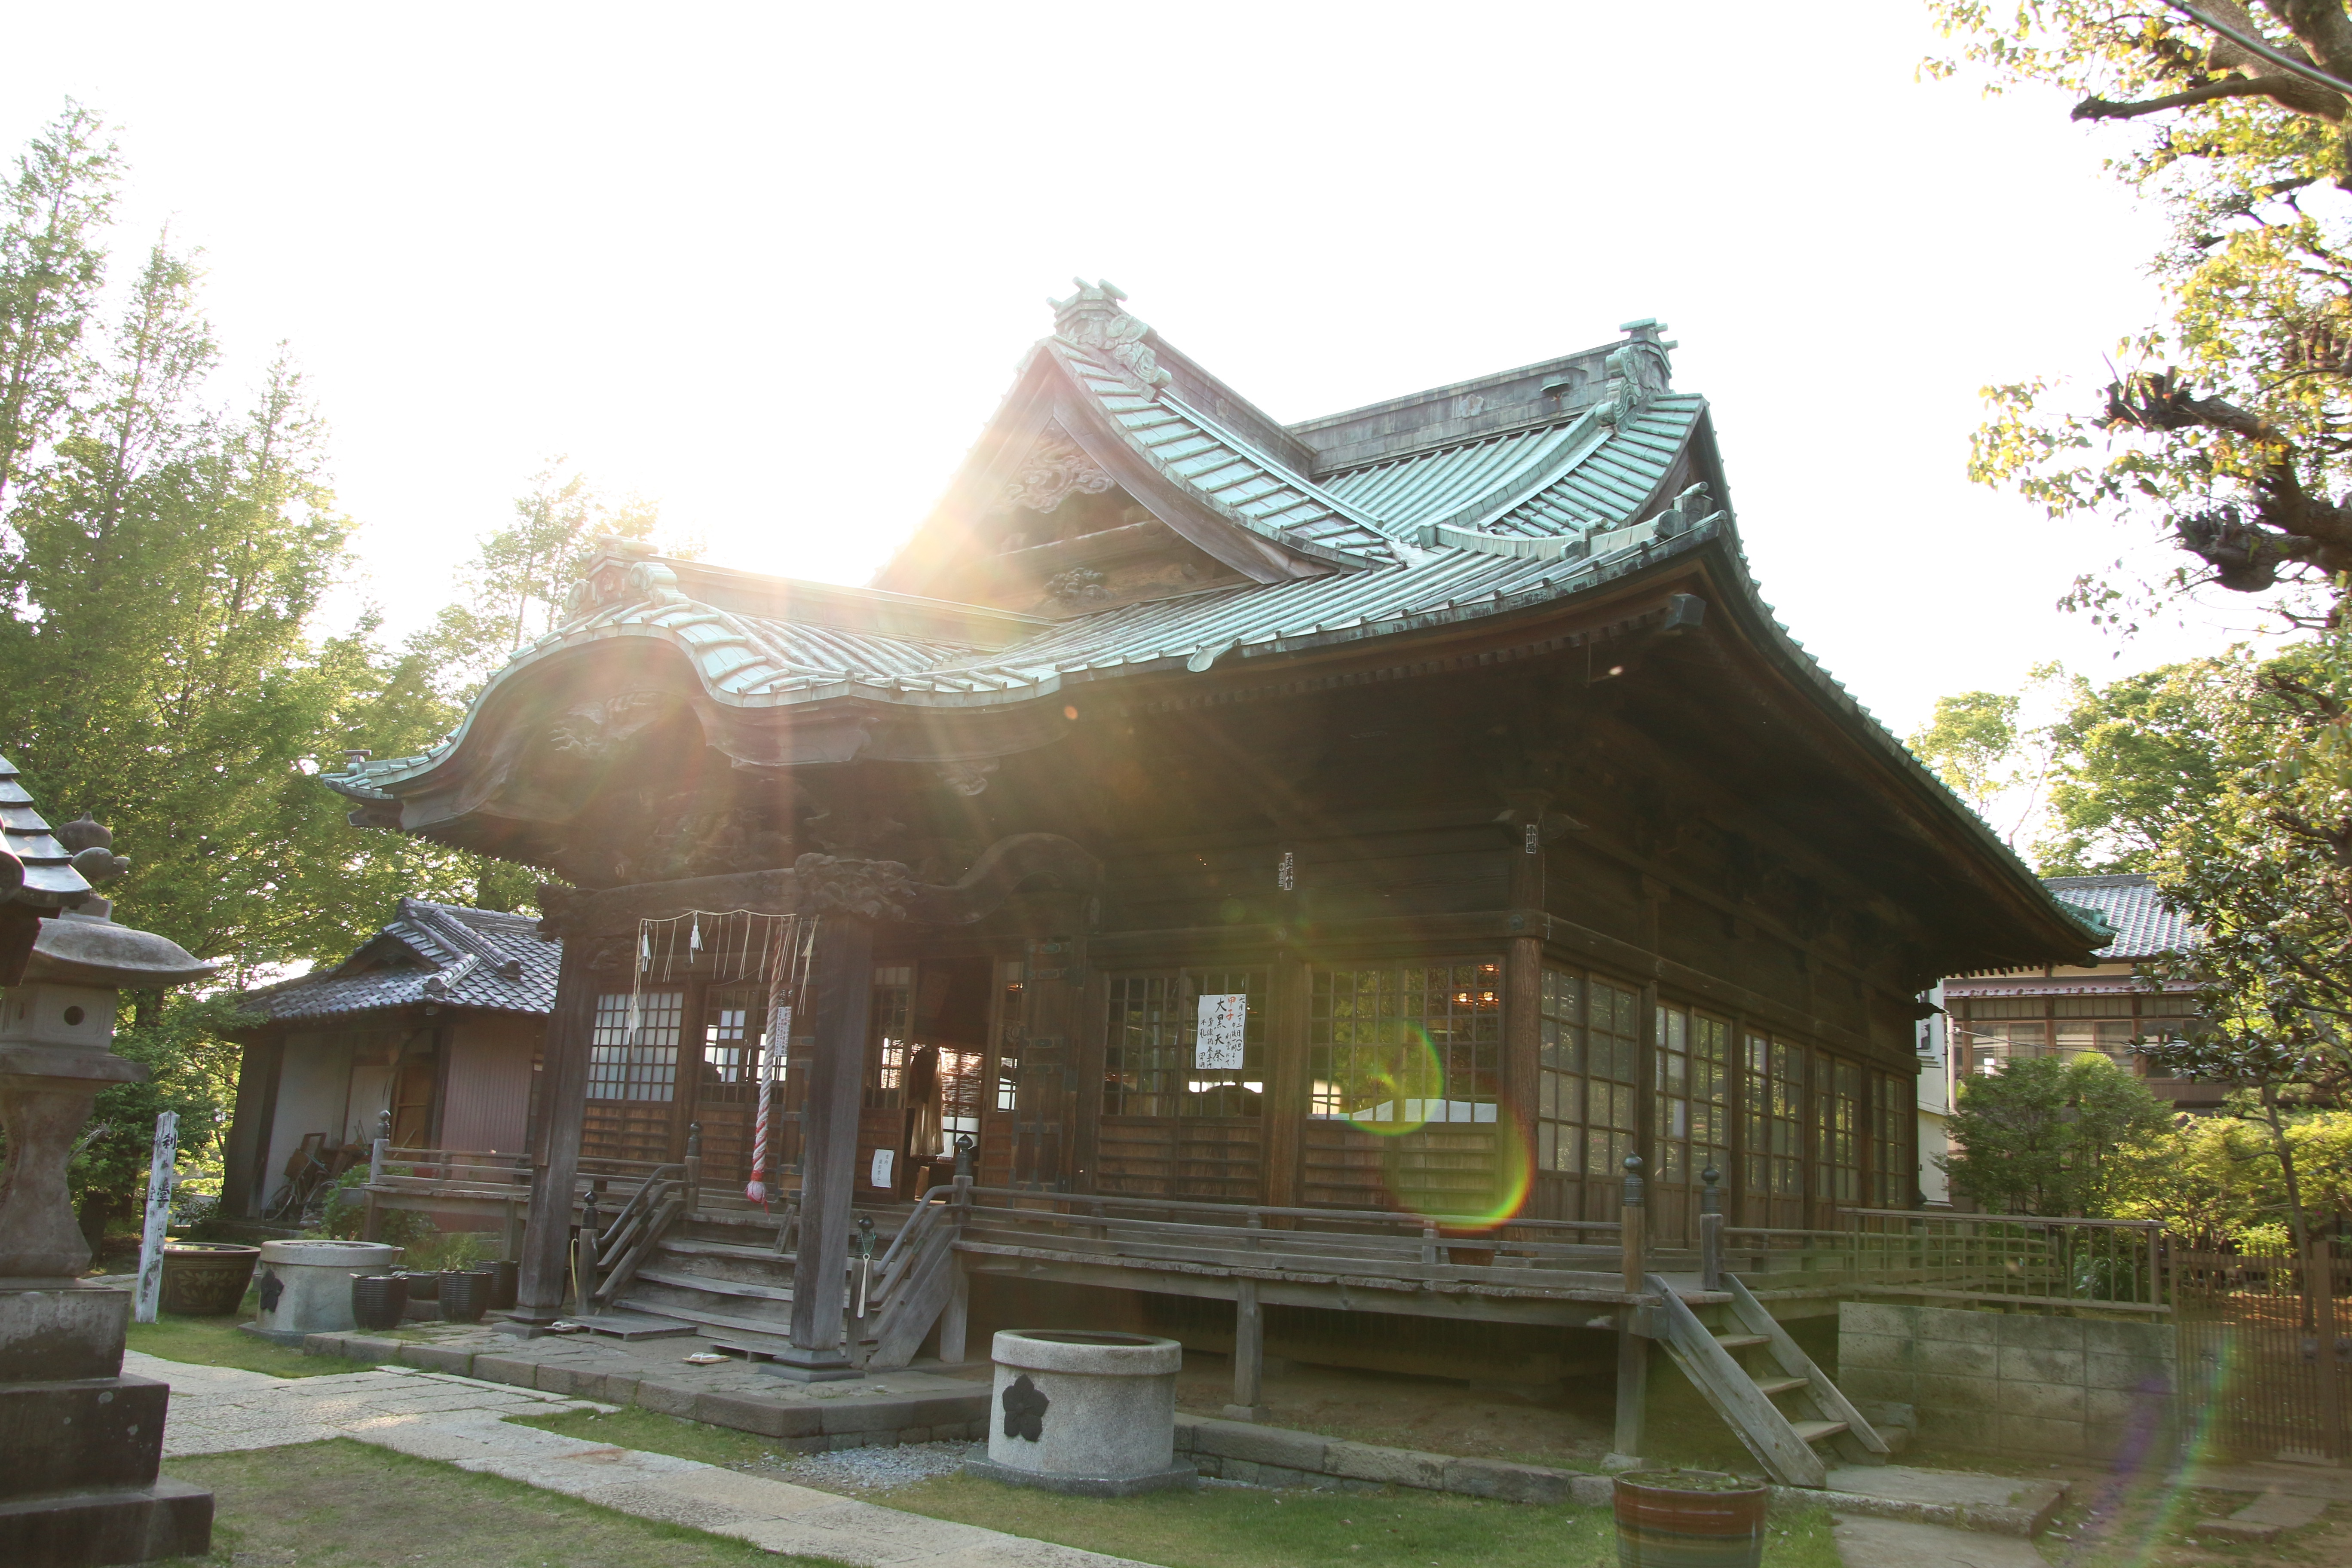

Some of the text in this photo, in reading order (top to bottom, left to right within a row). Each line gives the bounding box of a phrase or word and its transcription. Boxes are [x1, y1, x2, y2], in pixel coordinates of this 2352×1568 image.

[1212, 997, 1227, 1062] 大黒天祭
[1226, 996, 1237, 1021] 甲子
[156, 1132, 177, 1202] 刹堂
